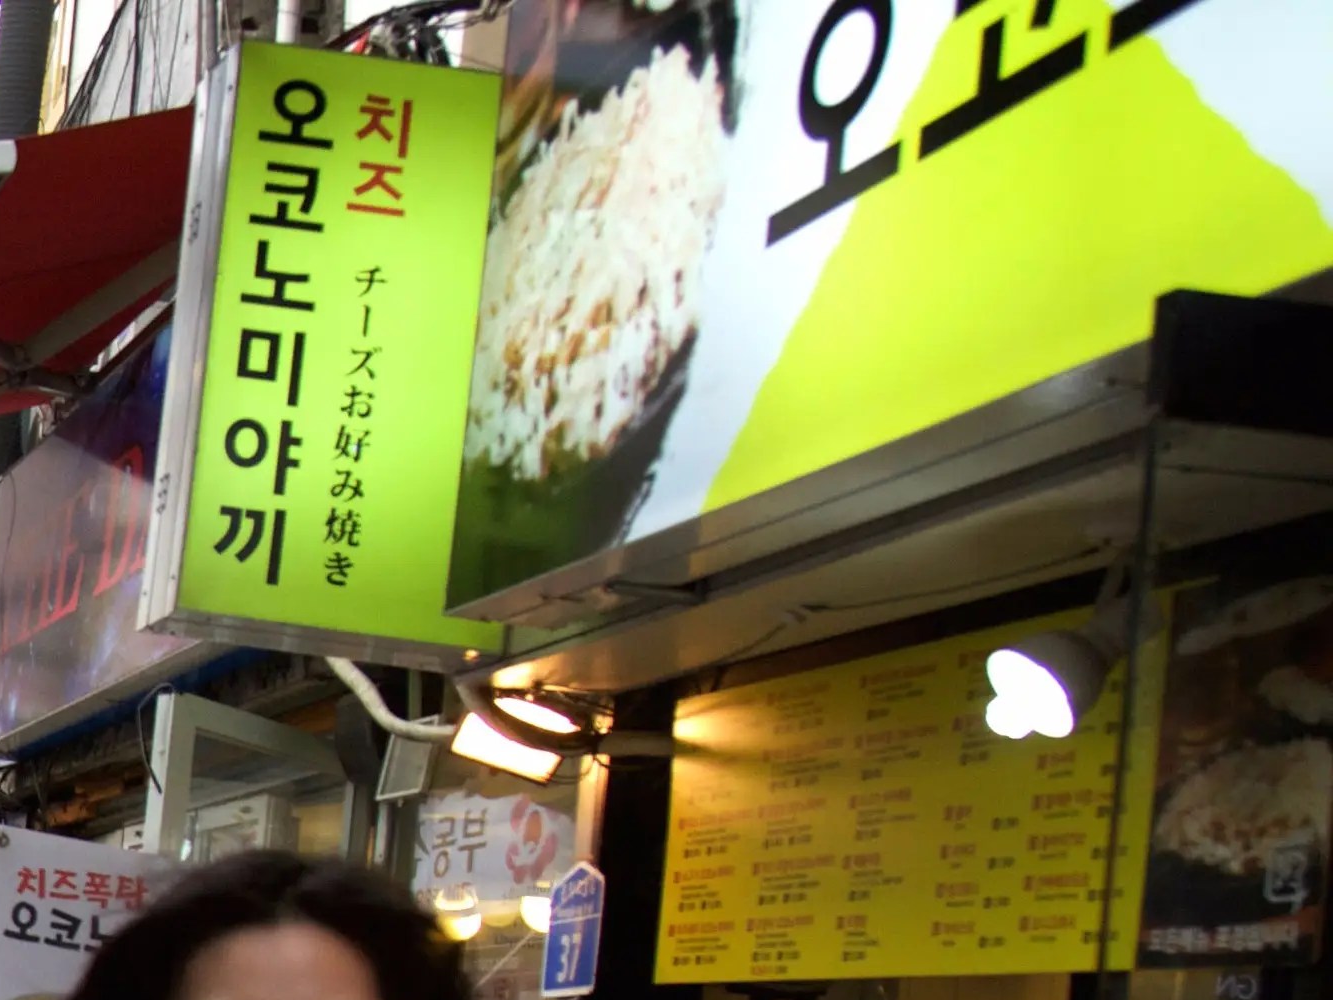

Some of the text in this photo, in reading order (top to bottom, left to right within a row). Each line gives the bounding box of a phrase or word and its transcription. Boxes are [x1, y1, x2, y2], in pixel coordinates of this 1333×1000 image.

[346, 92, 413, 218] 치즈
[213, 79, 333, 586] 오코노미야끼
[323, 265, 388, 588] チーズお好み焼き
[17, 866, 150, 911] 치즈폭탄
[557, 932, 581, 984] 37
